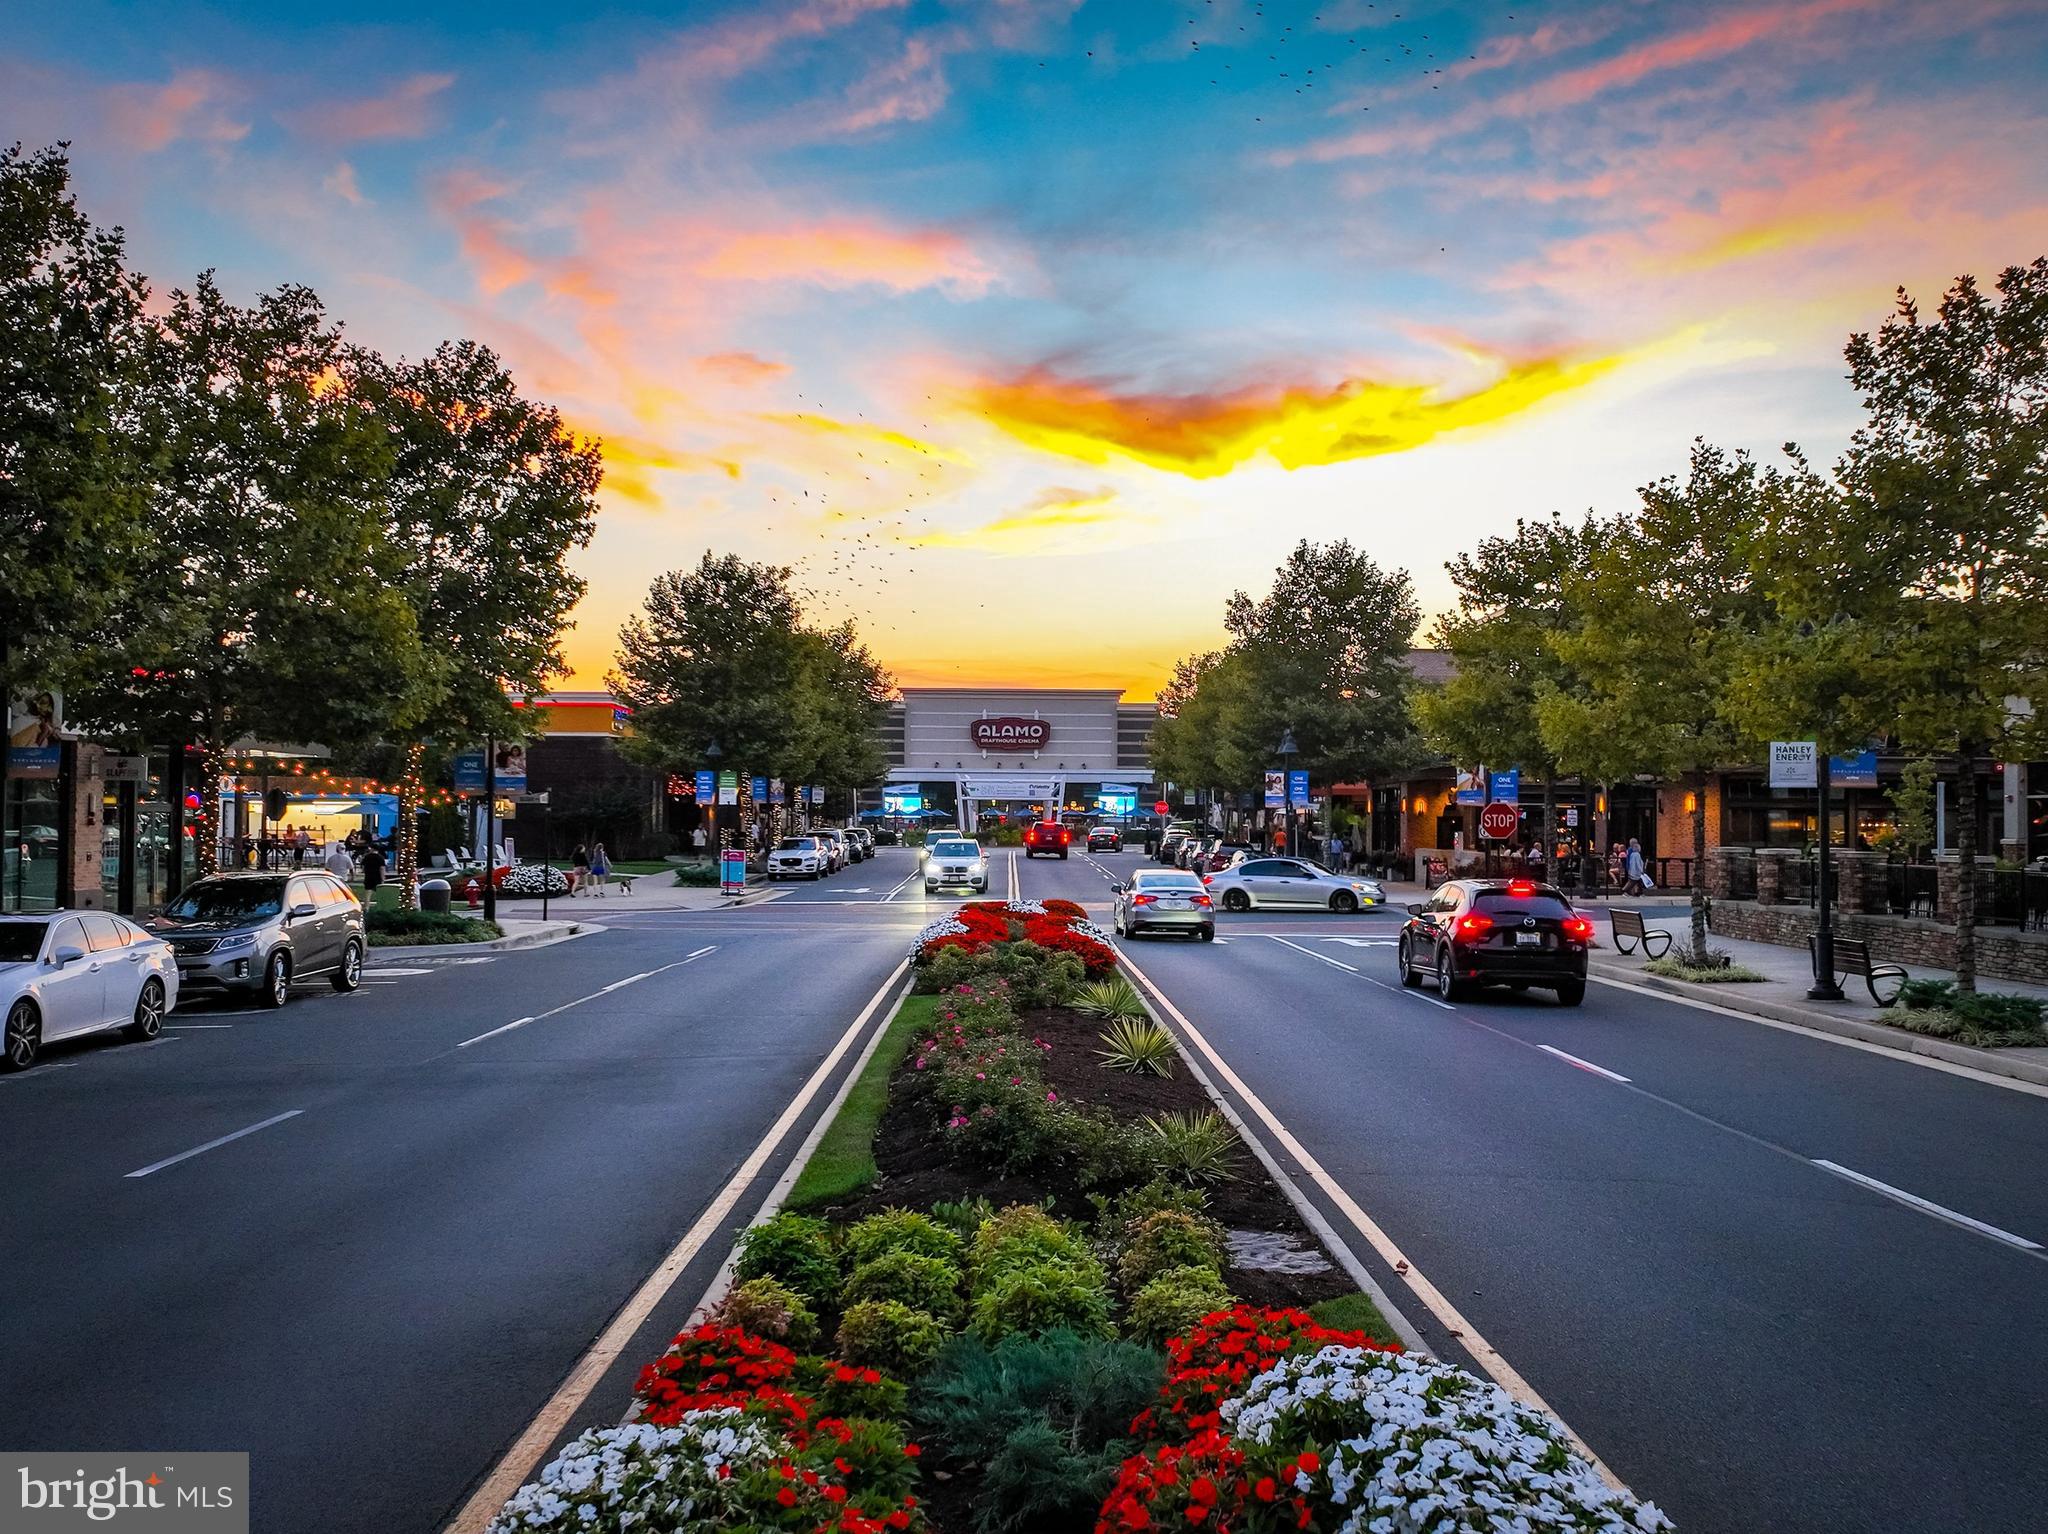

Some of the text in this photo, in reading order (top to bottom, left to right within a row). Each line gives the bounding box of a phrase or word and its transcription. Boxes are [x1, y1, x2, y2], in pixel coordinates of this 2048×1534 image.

[978, 725, 1043, 737] ALAMO
[1776, 746, 1812, 754] HANLEY
[1483, 814, 1514, 828] STOP
